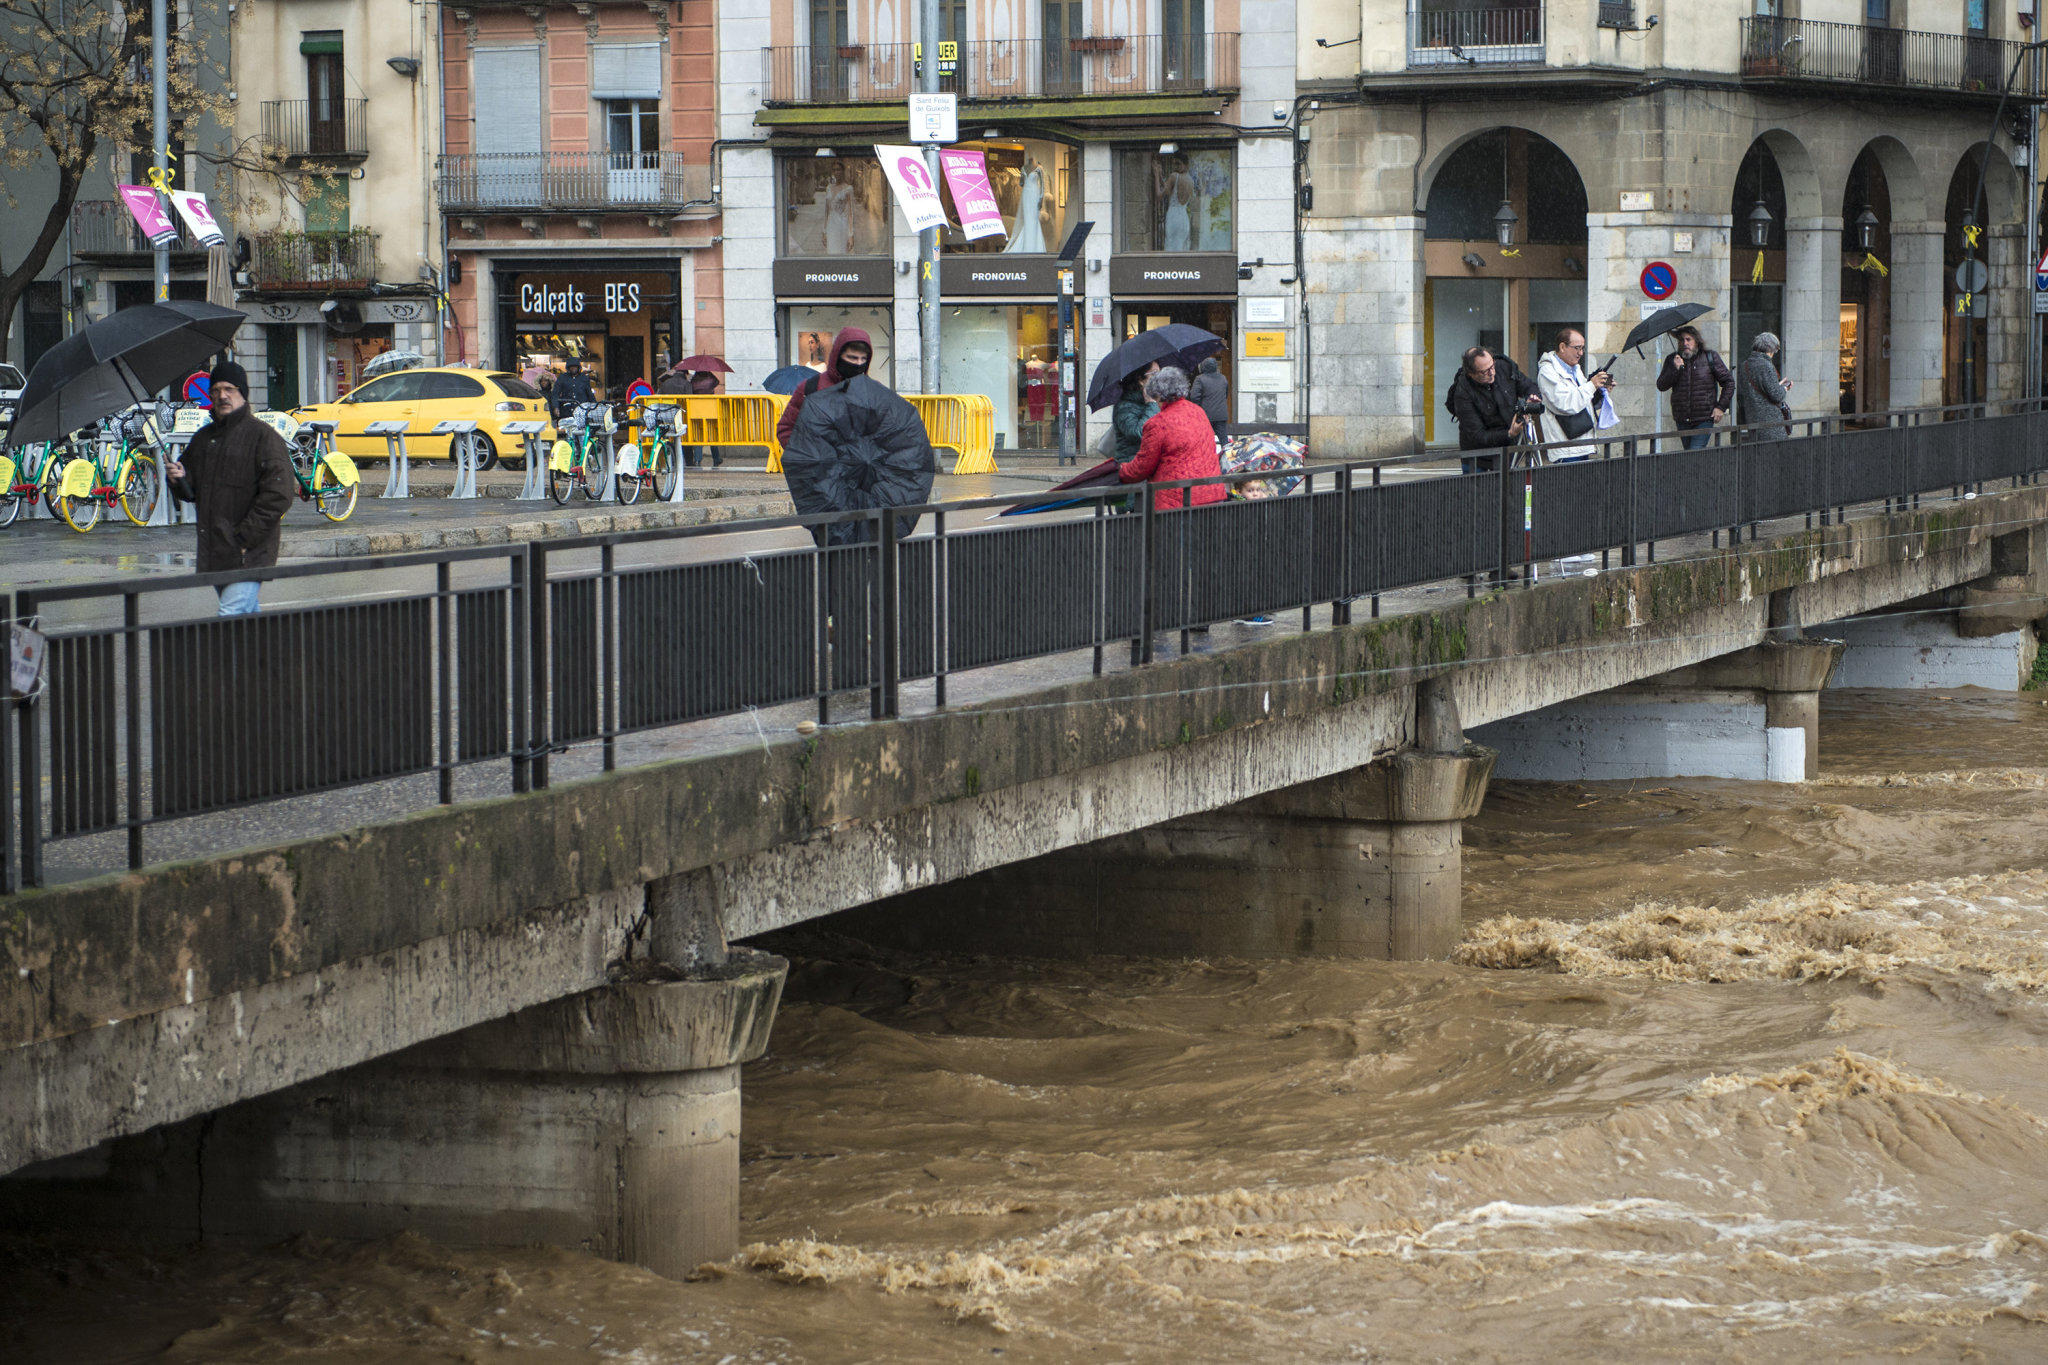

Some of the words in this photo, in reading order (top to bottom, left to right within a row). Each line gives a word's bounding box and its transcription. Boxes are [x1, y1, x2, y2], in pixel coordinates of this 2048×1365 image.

[805, 273, 859, 282] PRONOVIAS
[971, 272, 1027, 281] PRONOVIAS
[1143, 271, 1201, 280] PRONOVIAS
[521, 283, 584, 316] Calçats
[604, 283, 640, 312] BES
